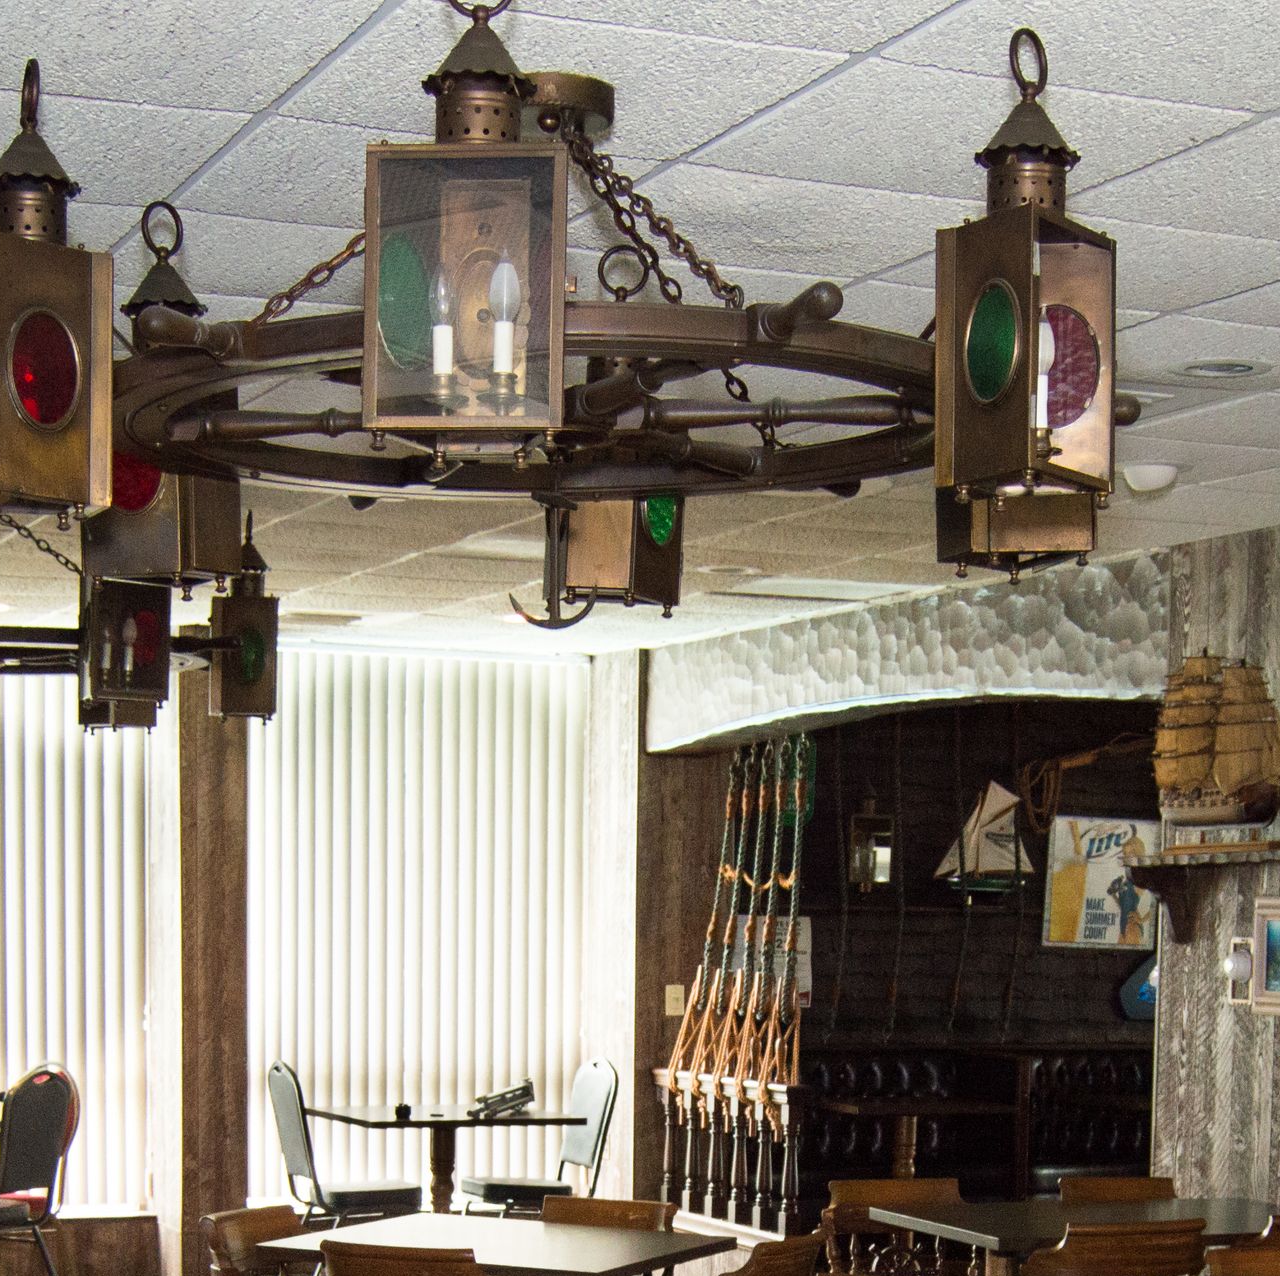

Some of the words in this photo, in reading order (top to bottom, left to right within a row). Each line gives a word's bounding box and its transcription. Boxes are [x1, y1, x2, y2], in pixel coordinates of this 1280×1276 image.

[1086, 898, 1105, 911] MAKE
[1085, 912, 1116, 925] SUMMER
[1084, 926, 1107, 939] COUNT
